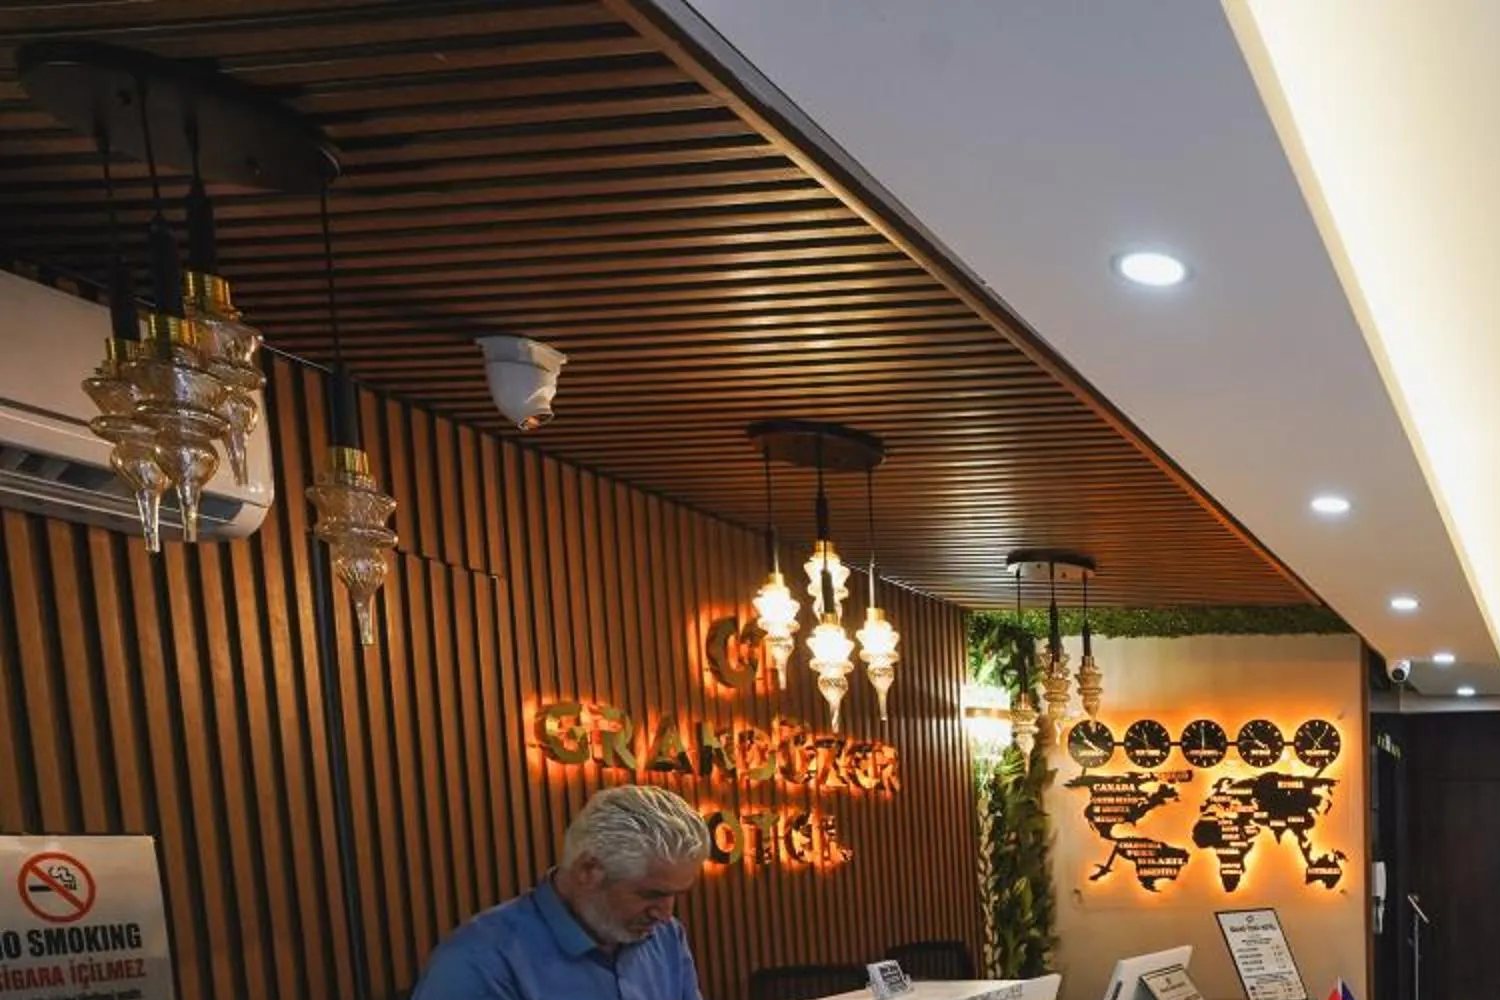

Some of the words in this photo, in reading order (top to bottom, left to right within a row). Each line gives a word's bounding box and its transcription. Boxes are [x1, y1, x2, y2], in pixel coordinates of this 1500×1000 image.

[535, 702, 775, 781] GRAND
[0, 931, 21, 960] O
[27, 923, 142, 956] SMOKING
[69, 957, 147, 989] İÇİLMEZ
